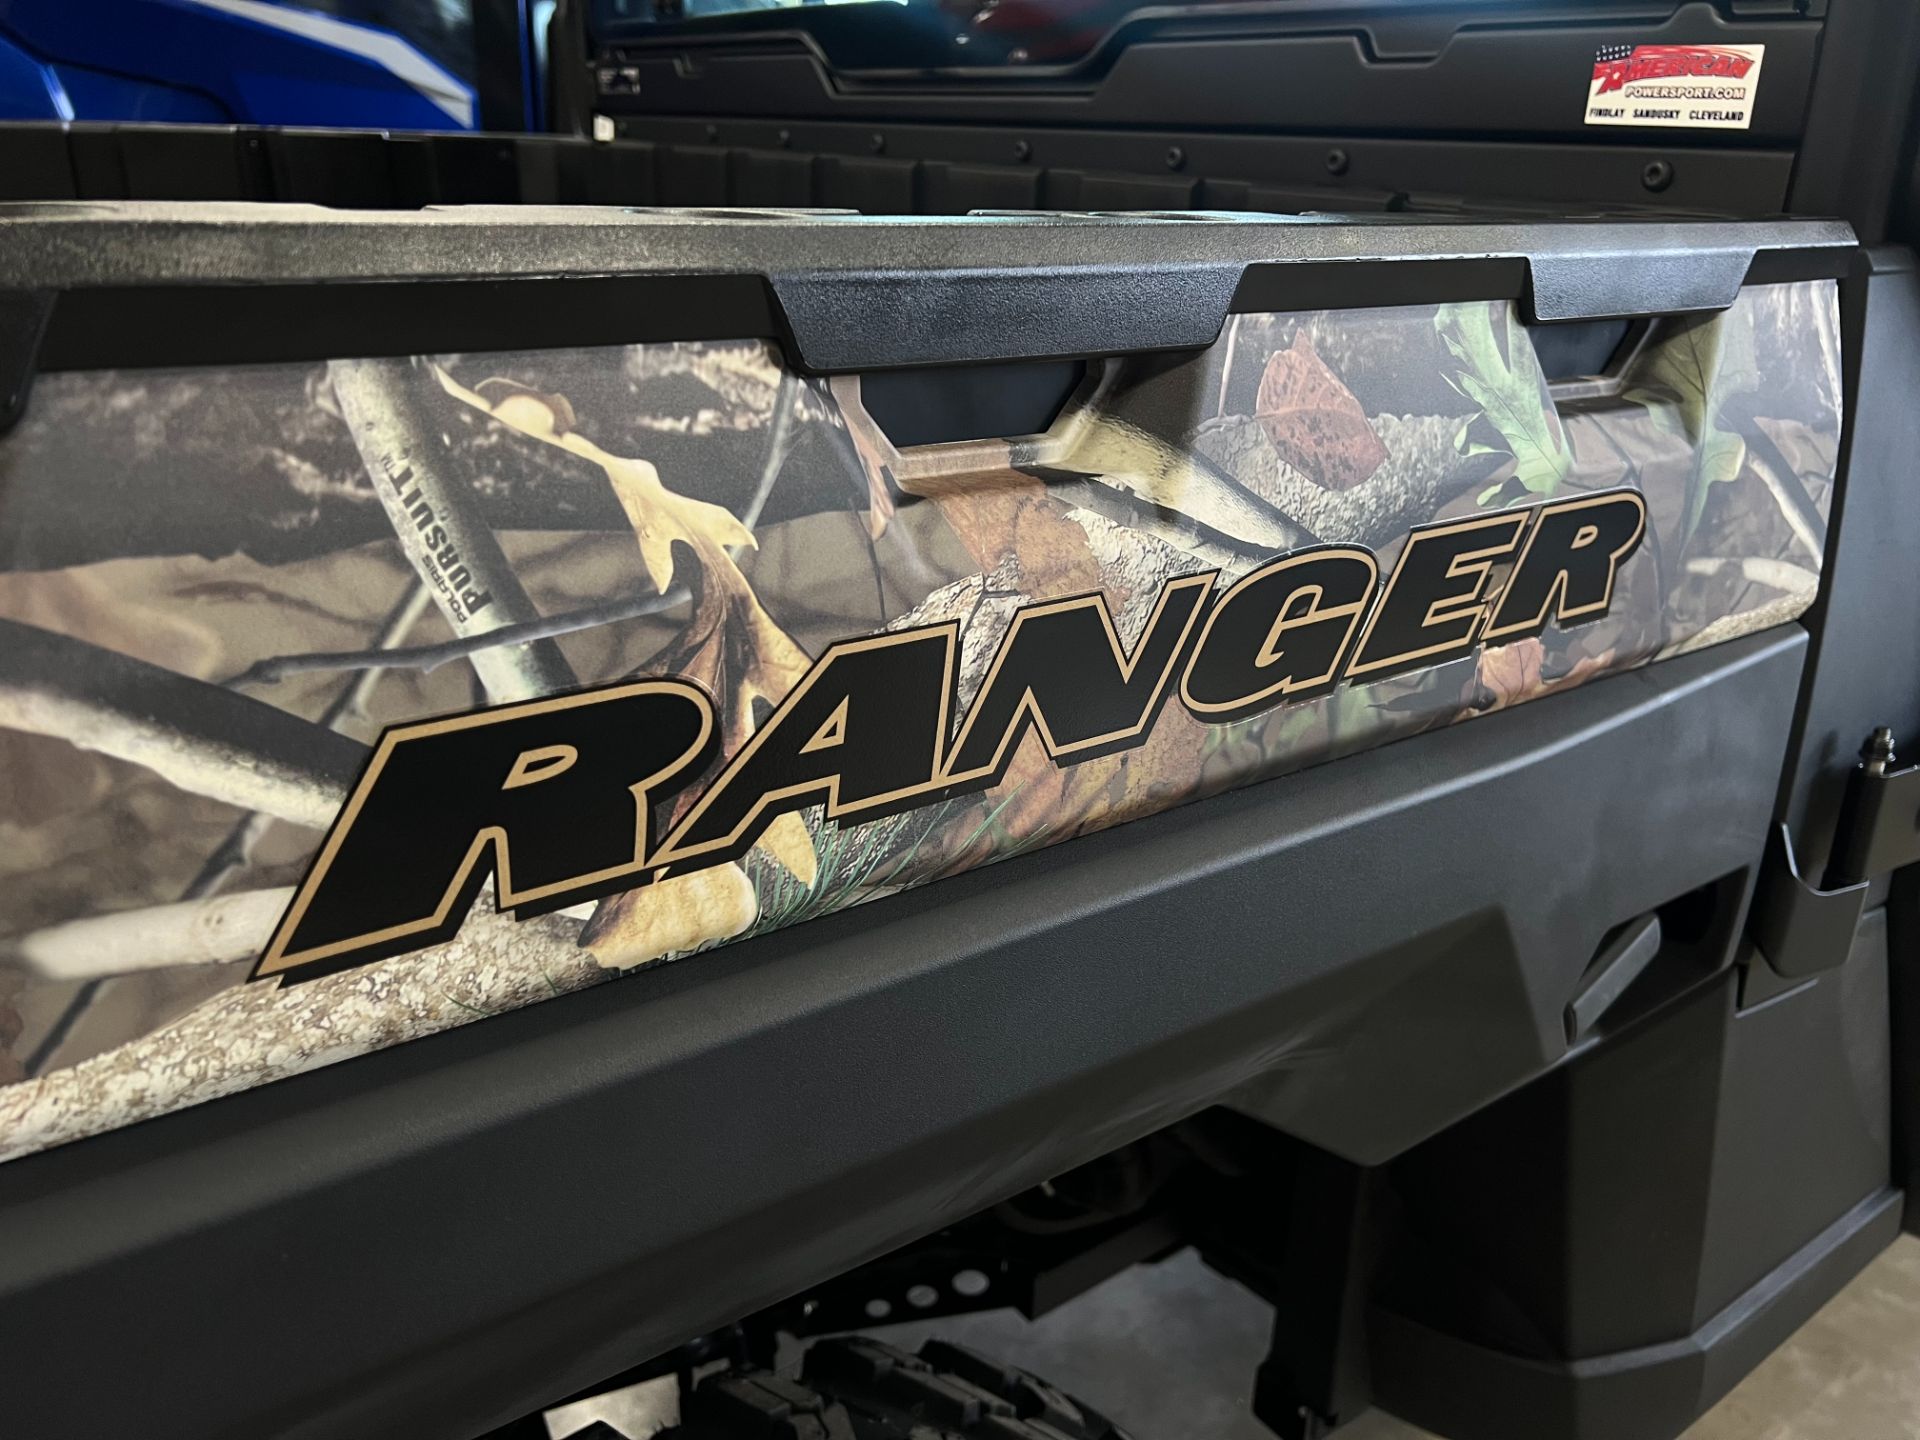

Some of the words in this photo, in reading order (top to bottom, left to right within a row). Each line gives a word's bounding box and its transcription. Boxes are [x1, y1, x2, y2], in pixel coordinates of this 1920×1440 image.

[1593, 56, 1754, 95] AMERICAN
[1625, 86, 1746, 99] POWERSPORT.COM
[1590, 108, 1625, 117] FINDLAY
[1633, 108, 1681, 119] SANDUSKY
[1689, 110, 1744, 121] CLEVELAND
[422, 554, 467, 623] POLARIS
[248, 490, 1646, 984] RANGER
